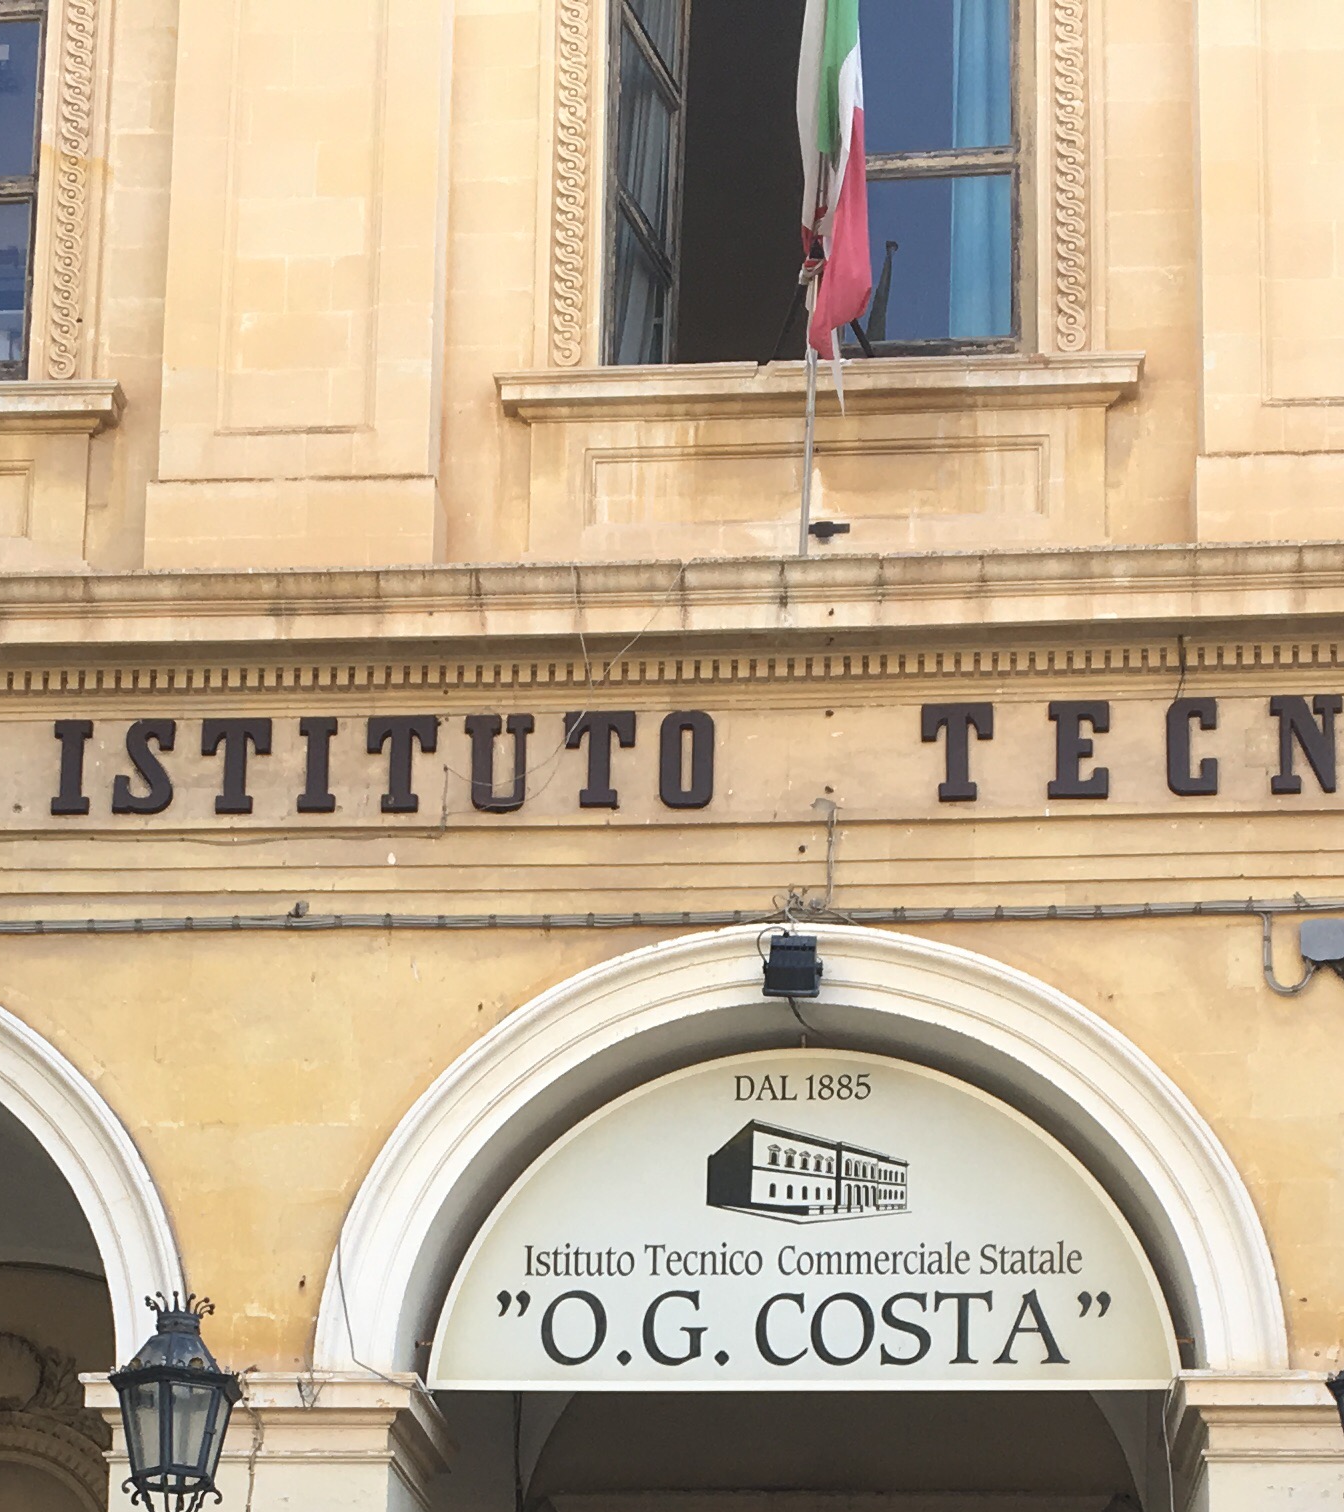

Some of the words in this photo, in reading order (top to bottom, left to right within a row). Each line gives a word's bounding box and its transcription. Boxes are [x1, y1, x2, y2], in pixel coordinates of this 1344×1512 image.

[49, 709, 716, 817] ISTITUTO
[734, 1074, 797, 1102] DAL
[805, 1072, 872, 1101] 1885
[524, 1242, 635, 1277] Istituto
[644, 1241, 763, 1277] Tecnico
[777, 1240, 971, 1276] Commerciale
[980, 1240, 1083, 1275] Statale
